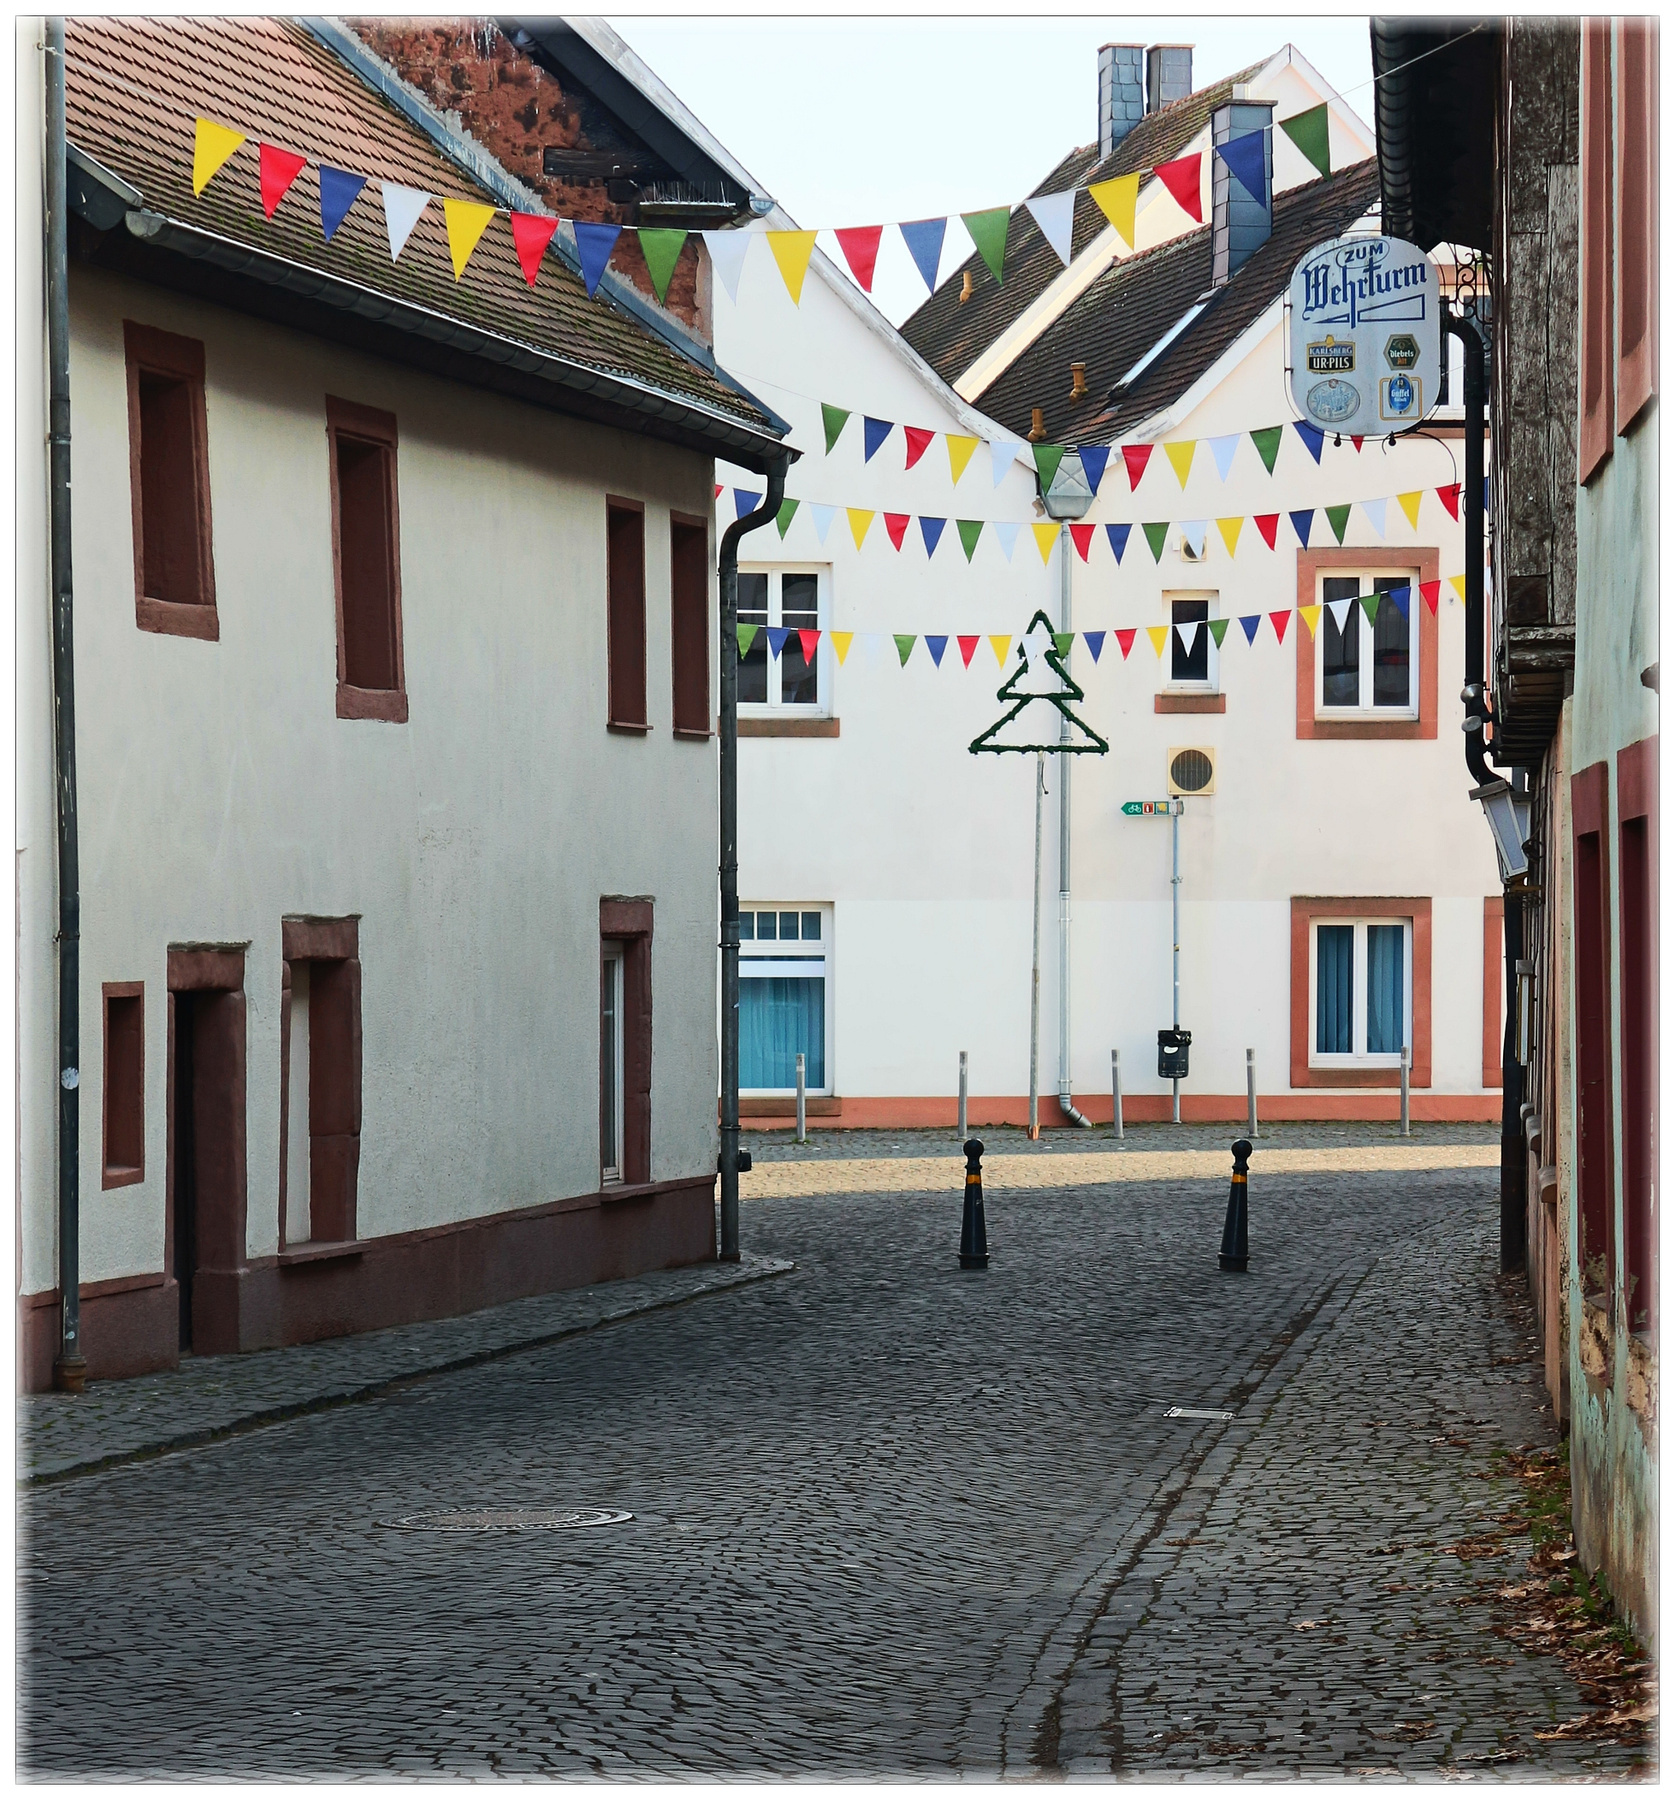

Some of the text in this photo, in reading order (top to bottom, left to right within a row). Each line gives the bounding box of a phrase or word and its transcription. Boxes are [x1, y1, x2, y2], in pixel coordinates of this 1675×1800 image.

[1344, 242, 1384, 264] ZUM
[1301, 257, 1427, 329] Wehrturm
[1309, 346, 1353, 355] KARLSBERG
[1390, 350, 1414, 358] Diebels
